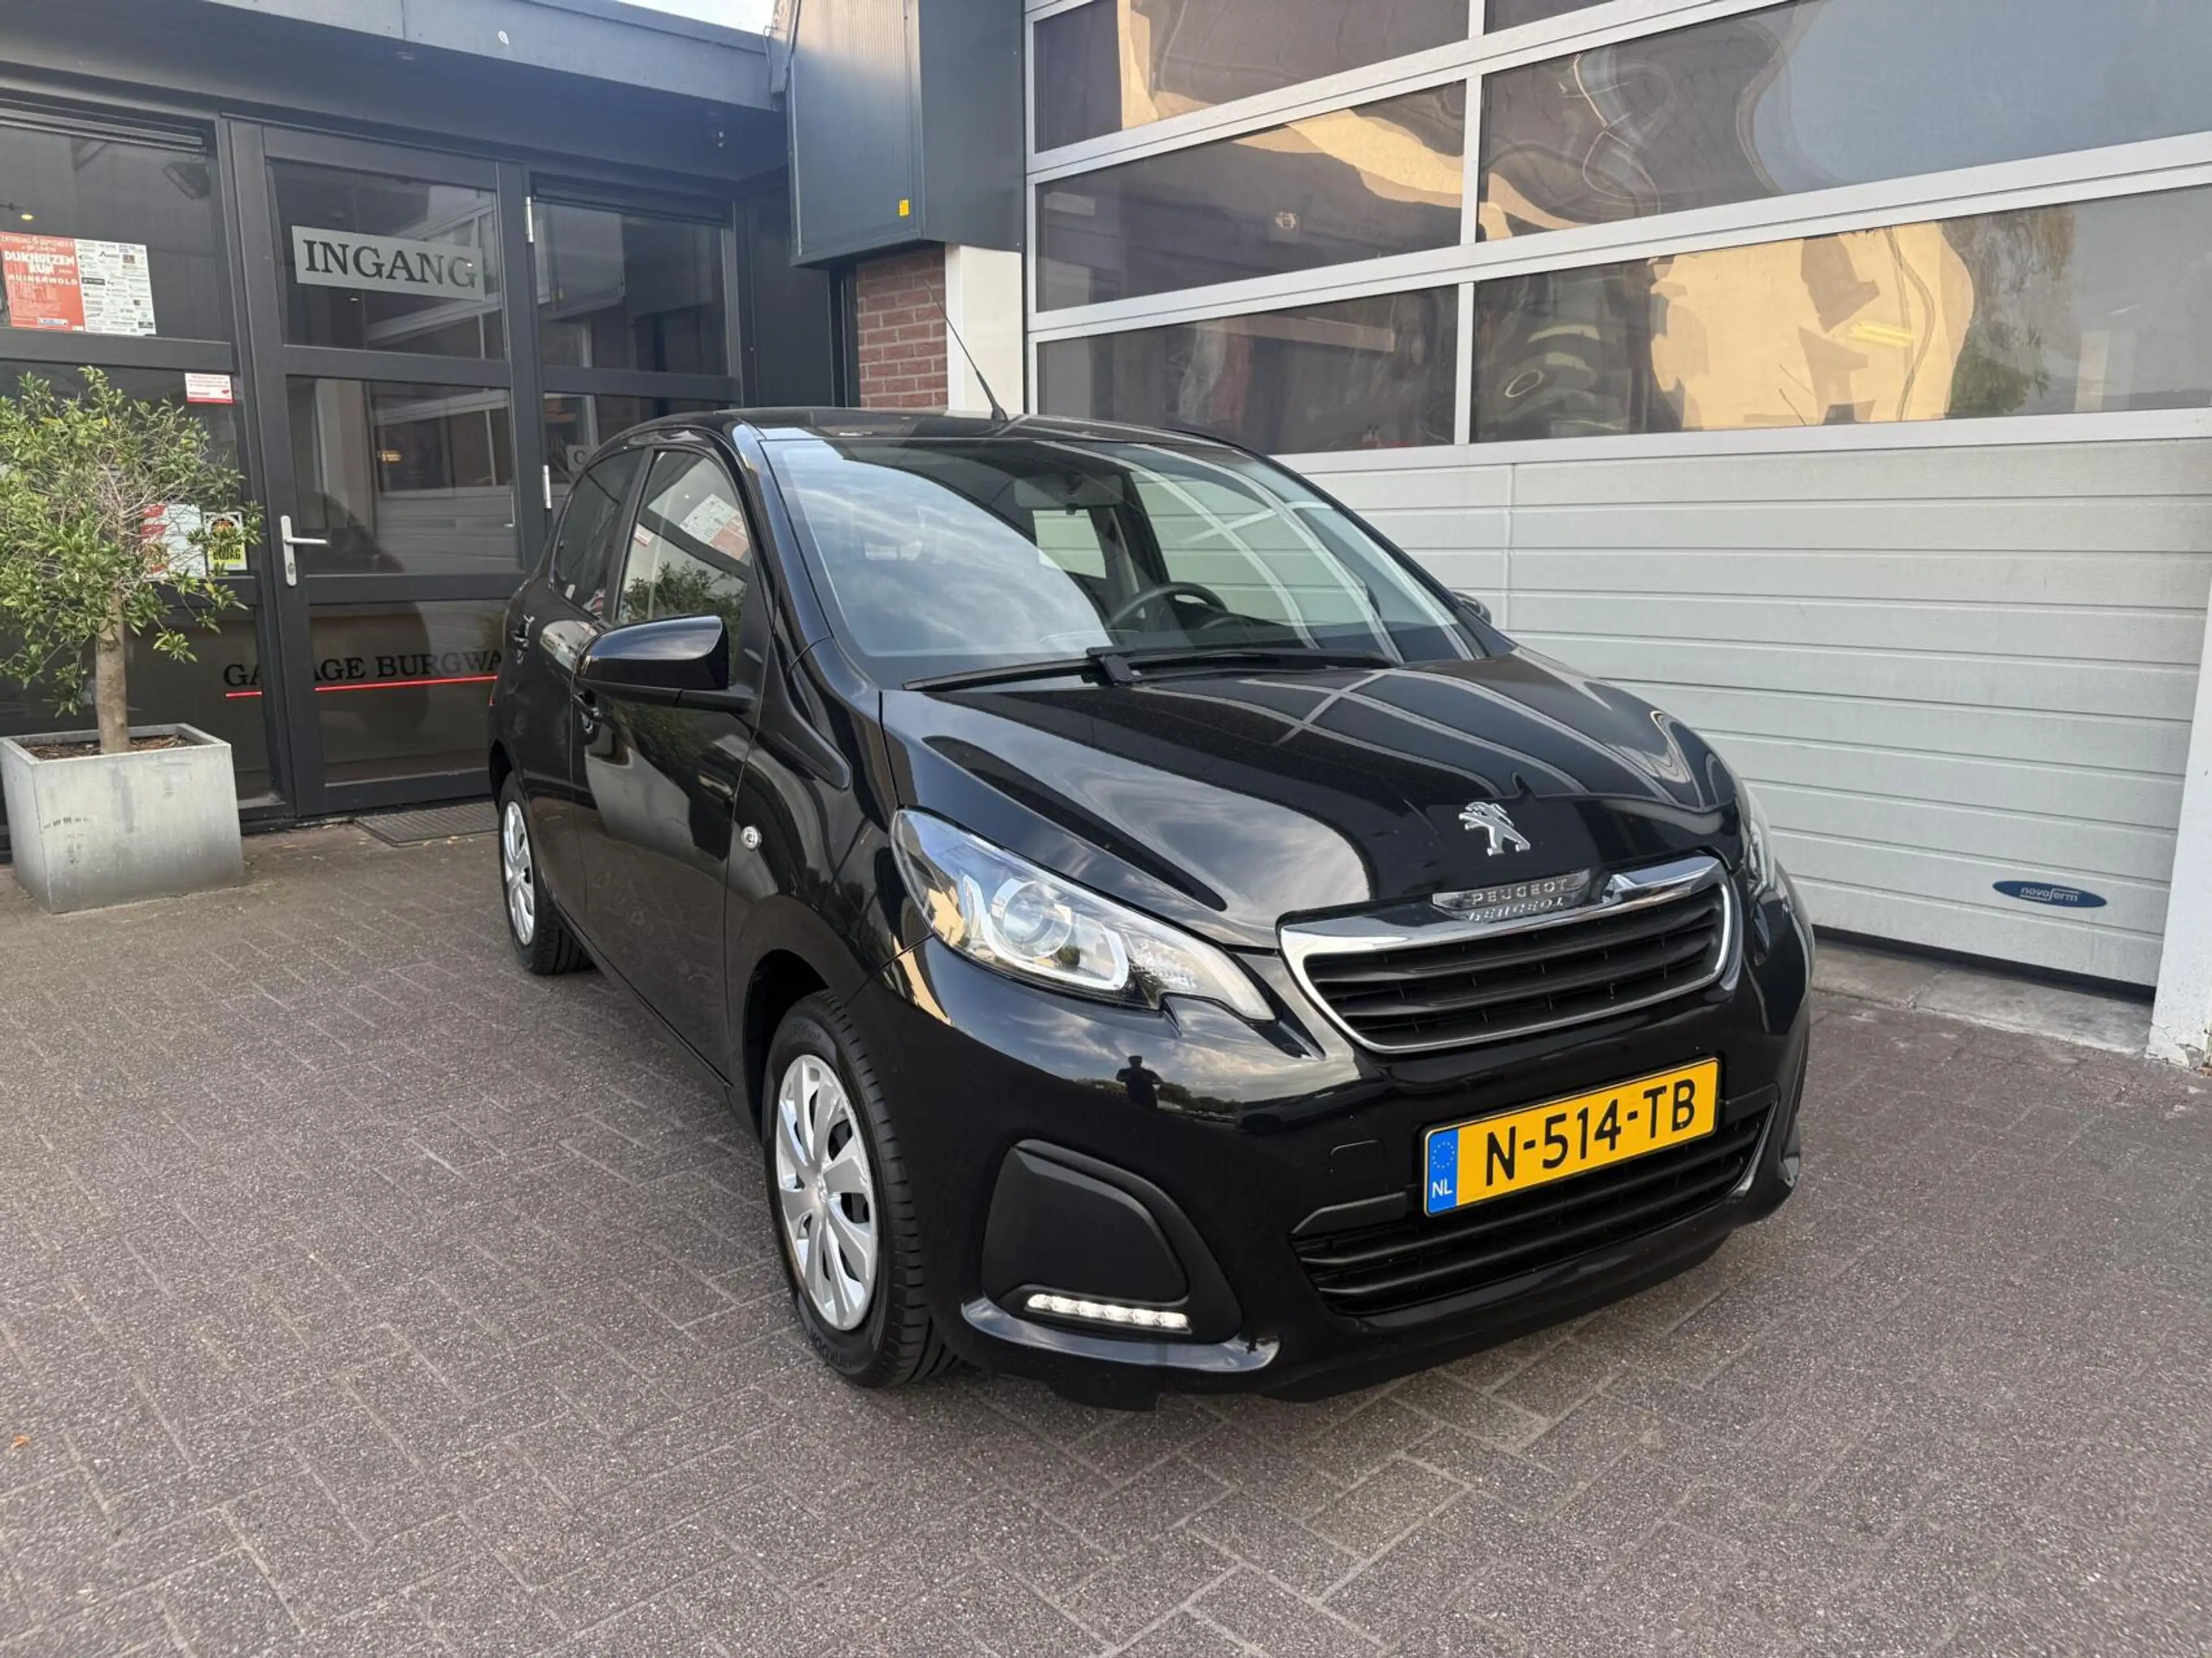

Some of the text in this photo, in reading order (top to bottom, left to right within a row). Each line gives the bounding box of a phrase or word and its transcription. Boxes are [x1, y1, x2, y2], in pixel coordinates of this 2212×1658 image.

[302, 239, 478, 288] INGANG
[223, 650, 502, 686] GAGE BURGWA
[1472, 878, 1567, 905] PEUGEOT
[1486, 1079, 1696, 1186] N-514-TB
[1431, 1178, 1452, 1198] NL
